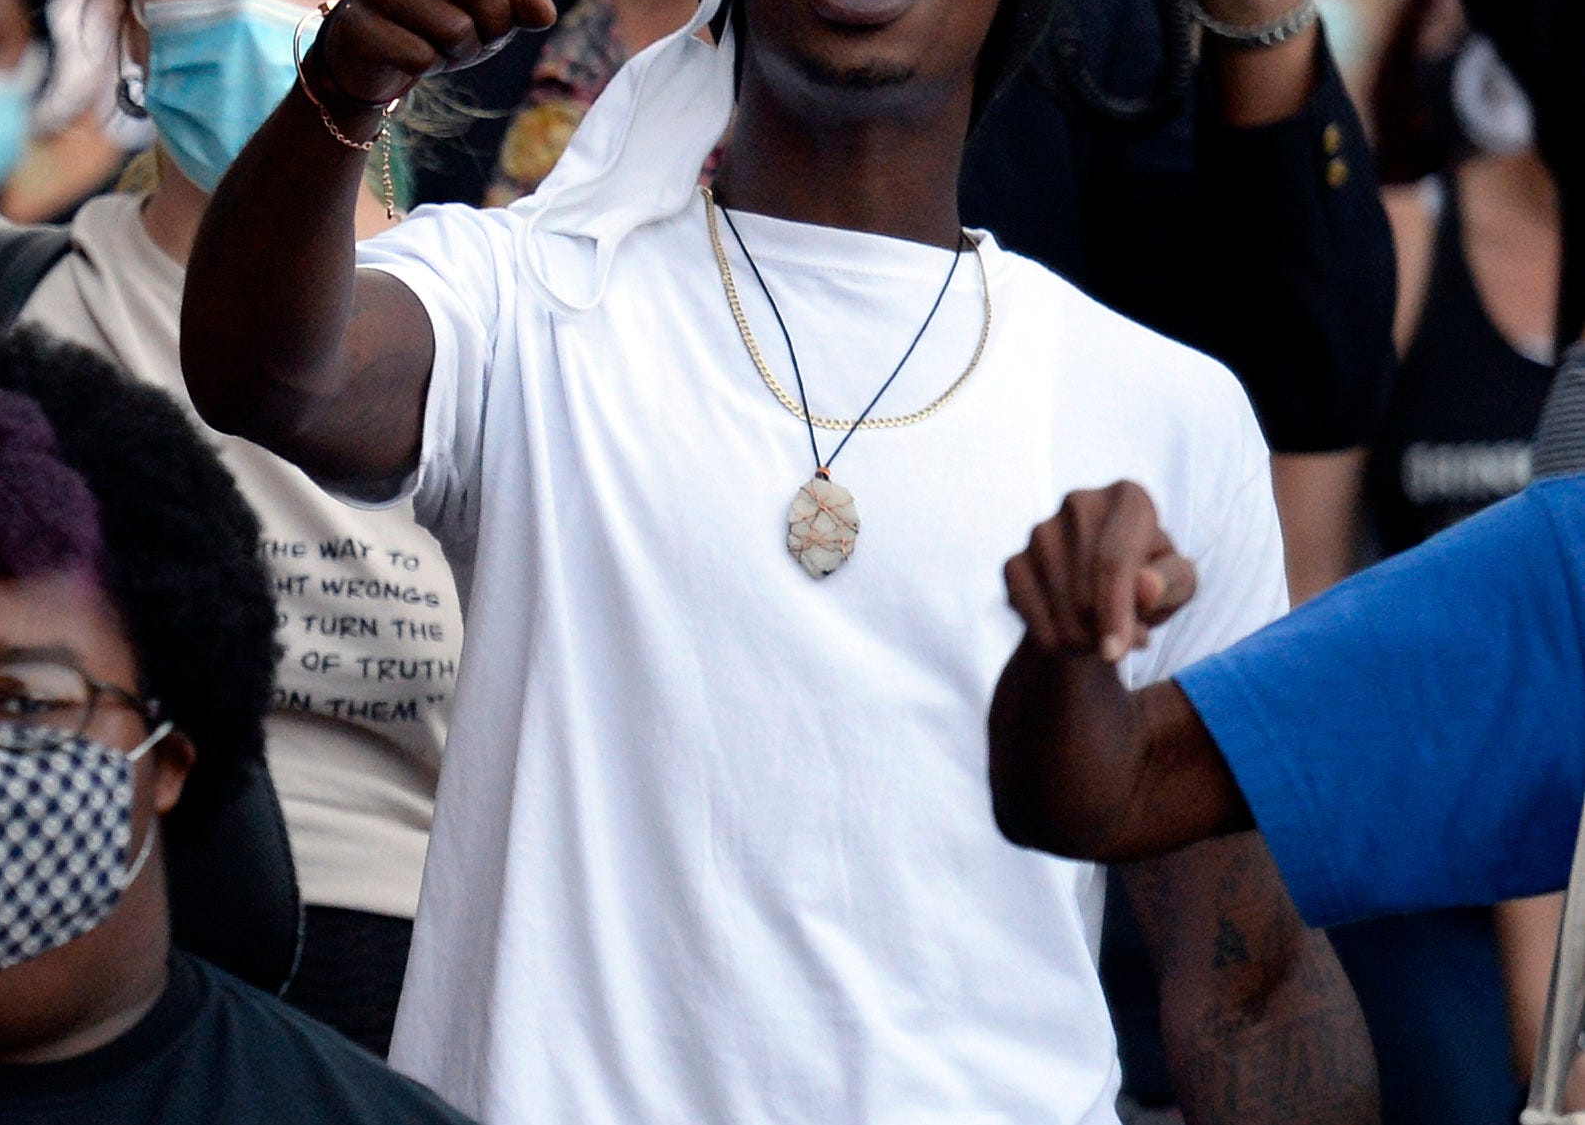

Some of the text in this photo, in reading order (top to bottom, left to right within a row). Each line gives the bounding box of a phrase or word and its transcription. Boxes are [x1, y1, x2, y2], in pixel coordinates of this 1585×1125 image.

[319, 538, 371, 559] WAY
[390, 552, 420, 571] TO
[321, 579, 440, 607] WRONGS
[304, 614, 378, 639] TURN
[392, 619, 444, 641] THE
[300, 651, 340, 673] OF
[356, 658, 455, 682] TRUTH
